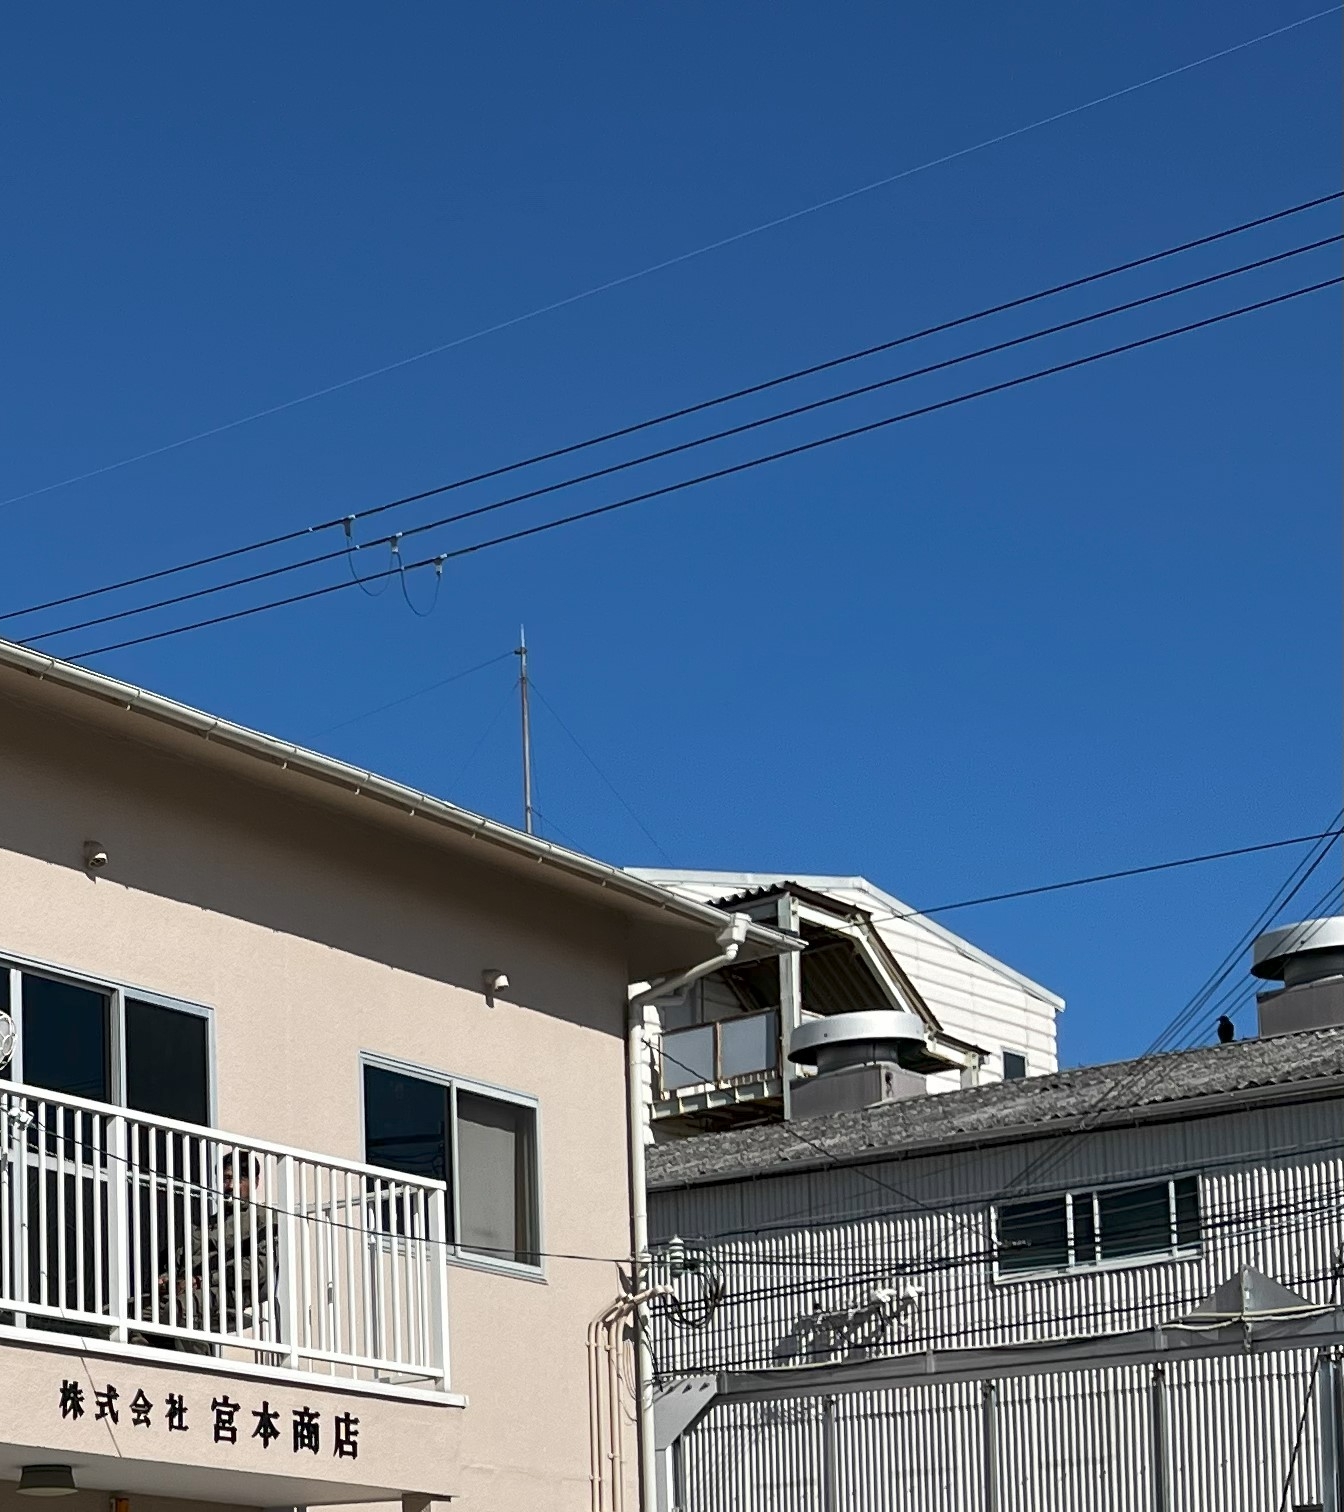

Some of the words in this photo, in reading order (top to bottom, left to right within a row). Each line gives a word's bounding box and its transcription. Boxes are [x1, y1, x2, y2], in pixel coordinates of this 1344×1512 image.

[59, 1379, 189, 1432] 株式会社
[211, 1394, 360, 1460] 宮本商店
